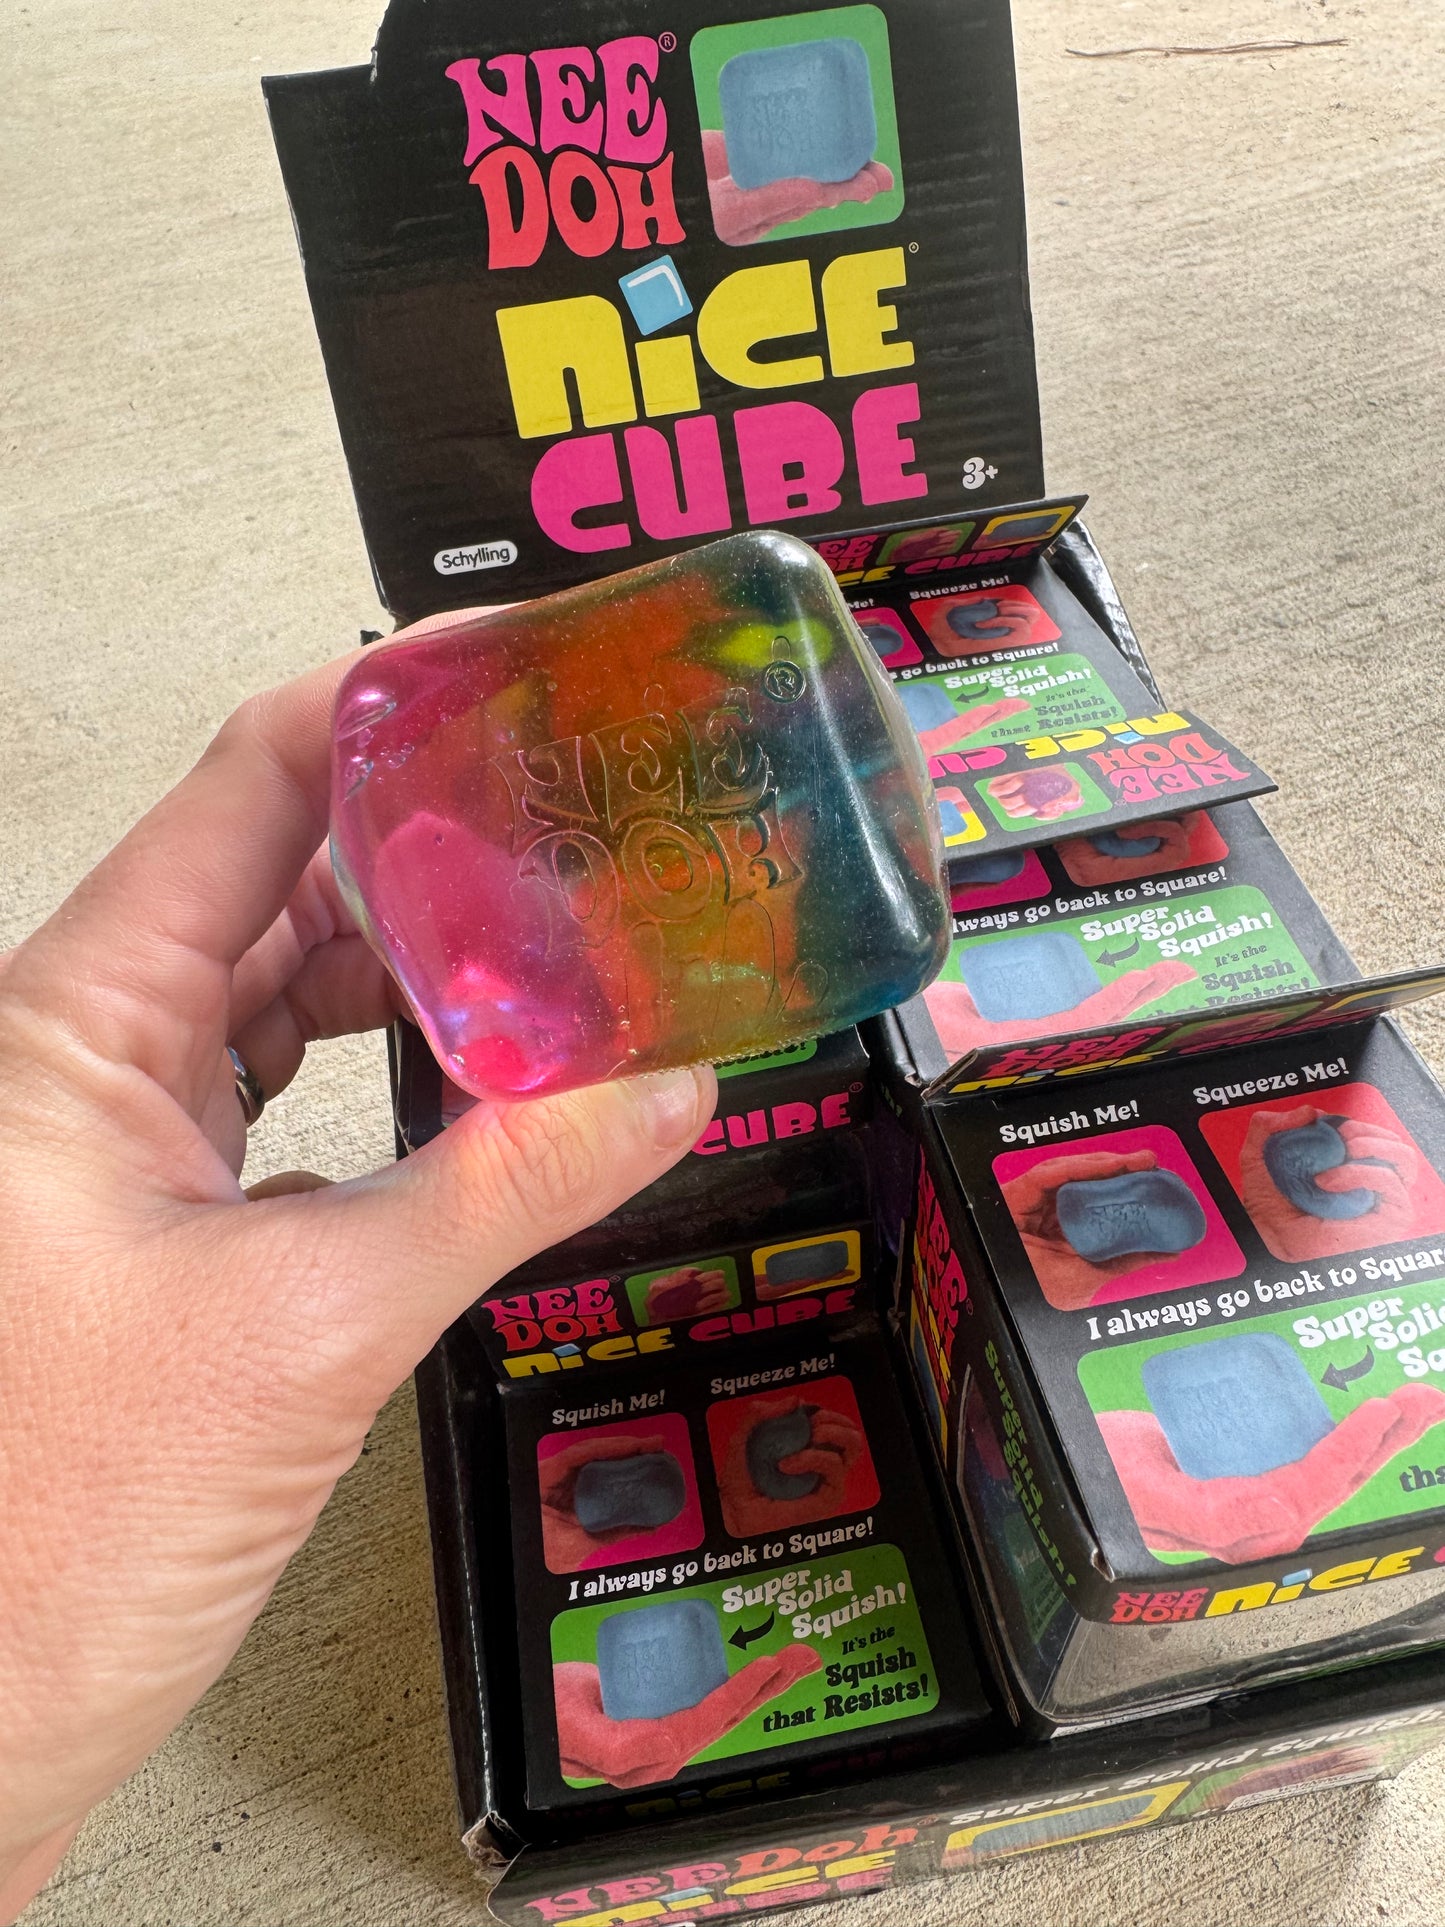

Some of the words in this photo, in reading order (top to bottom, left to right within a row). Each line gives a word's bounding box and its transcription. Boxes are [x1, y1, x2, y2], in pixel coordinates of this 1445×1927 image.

[445, 36, 669, 167] NEE
[468, 146, 686, 270] DOH
[531, 383, 929, 554] CUBE
[962, 457, 999, 490] 3+
[441, 546, 511, 569] Schylling
[814, 534, 880, 558] EE
[909, 581, 978, 600] Squeeze
[981, 574, 1011, 588] Me!
[901, 666, 922, 680] go
[925, 657, 968, 673] back
[972, 655, 990, 666] to
[991, 642, 1061, 662] Square!
[943, 666, 1014, 690] Super
[989, 664, 1050, 688] Solid
[1002, 668, 1092, 698] Squish!
[1034, 695, 1106, 716] Squish
[1036, 706, 1119, 730] Resists!
[927, 746, 1008, 779] CU
[1087, 733, 1223, 776] DOH
[1107, 753, 1251, 803] NEE
[952, 909, 1020, 934] lways
[1024, 904, 1051, 924] go
[1056, 890, 1110, 914] back
[1115, 886, 1138, 902] to
[1140, 866, 1228, 901] Square!
[1080, 906, 1170, 942] Super
[1138, 905, 1217, 942] Solid
[1157, 912, 1274, 959] Squish!
[1201, 958, 1297, 992] Squish
[1214, 953, 1241, 968] It's
[1242, 944, 1268, 959] the
[1193, 1072, 1299, 1106] Squeeze
[1301, 1057, 1350, 1082] Me!
[690, 1091, 852, 1156] CUBE
[999, 1111, 1090, 1145] Squish
[1094, 1099, 1141, 1126] Me!
[481, 1278, 616, 1327] NEE
[688, 1289, 857, 1342] CUBE
[1086, 1316, 1102, 1340] I
[1108, 1294, 1212, 1337] always
[1216, 1289, 1251, 1317] go
[1253, 1270, 1325, 1303] back
[1328, 1264, 1358, 1287] to
[1359, 1247, 1445, 1283] Squar
[496, 1306, 624, 1352] DOH
[1293, 1296, 1404, 1350] Super
[1368, 1301, 1445, 1350] Soli
[710, 1364, 796, 1395] Squeeze
[799, 1352, 836, 1375] Me!
[552, 1398, 625, 1427] Squish
[628, 1390, 666, 1412] Me!
[568, 1580, 579, 1601] I
[583, 1565, 666, 1600] always
[672, 1561, 698, 1583] go
[703, 1544, 757, 1573] back
[763, 1541, 785, 1561] to
[789, 1516, 875, 1557] Square!
[721, 1569, 812, 1614] Super
[776, 1569, 854, 1616] Solid
[791, 1582, 907, 1640] Squish!
[1117, 1588, 1210, 1608] NEE
[1109, 1605, 1203, 1623] DOH
[841, 1637, 867, 1656] It's
[870, 1624, 896, 1645] the
[825, 1646, 917, 1690] Squish
[763, 1702, 817, 1734] that
[823, 1673, 930, 1721] Resists!
[949, 1785, 1110, 1827] Super
[1118, 1747, 1259, 1792] Solid
